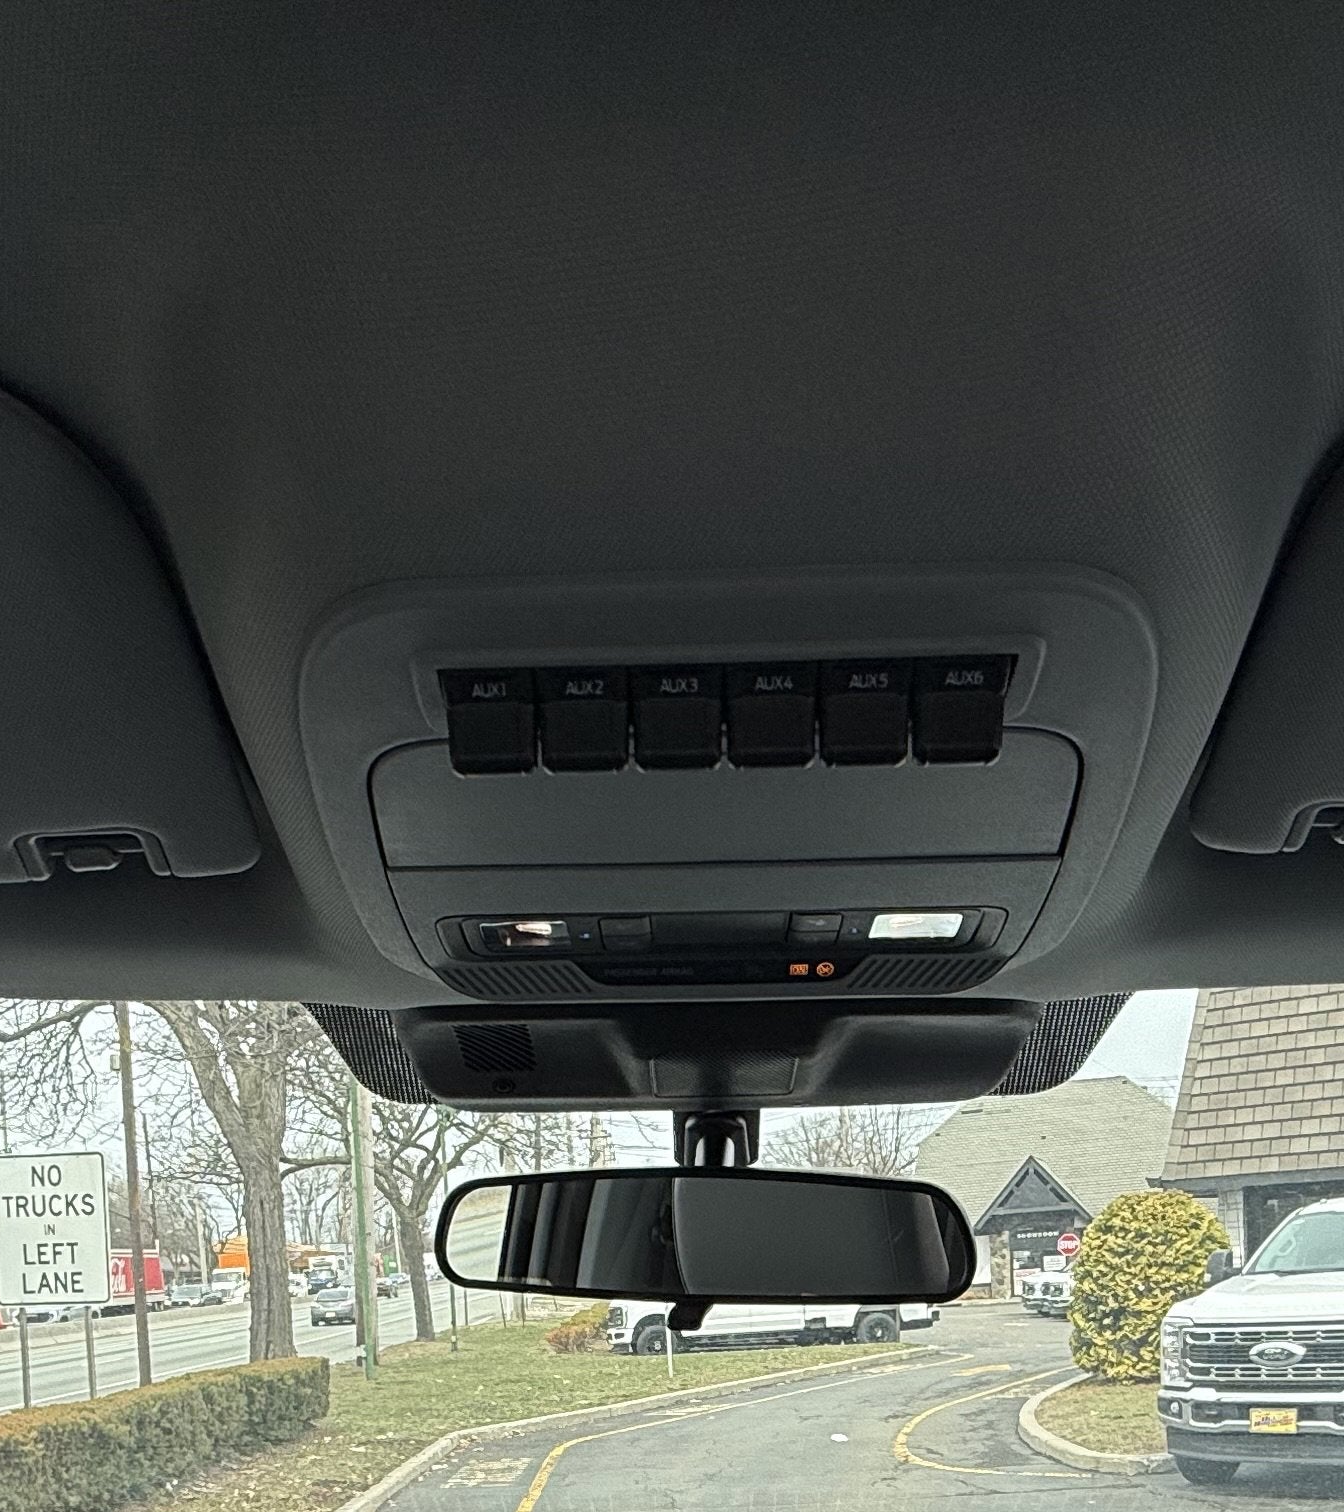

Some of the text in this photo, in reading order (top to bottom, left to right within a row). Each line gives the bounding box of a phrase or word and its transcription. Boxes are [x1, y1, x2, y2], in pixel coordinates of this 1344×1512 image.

[565, 677, 605, 696] AUX2
[659, 676, 699, 694] AUX3
[754, 675, 794, 693] AUX4
[848, 673, 889, 690] AUX5
[945, 670, 985, 687] AUX6
[30, 1164, 63, 1188] NO
[1, 1192, 96, 1218] TRUCKS
[43, 1223, 56, 1236] IN
[22, 1241, 79, 1266] LEFT
[22, 1271, 85, 1295] LANE
